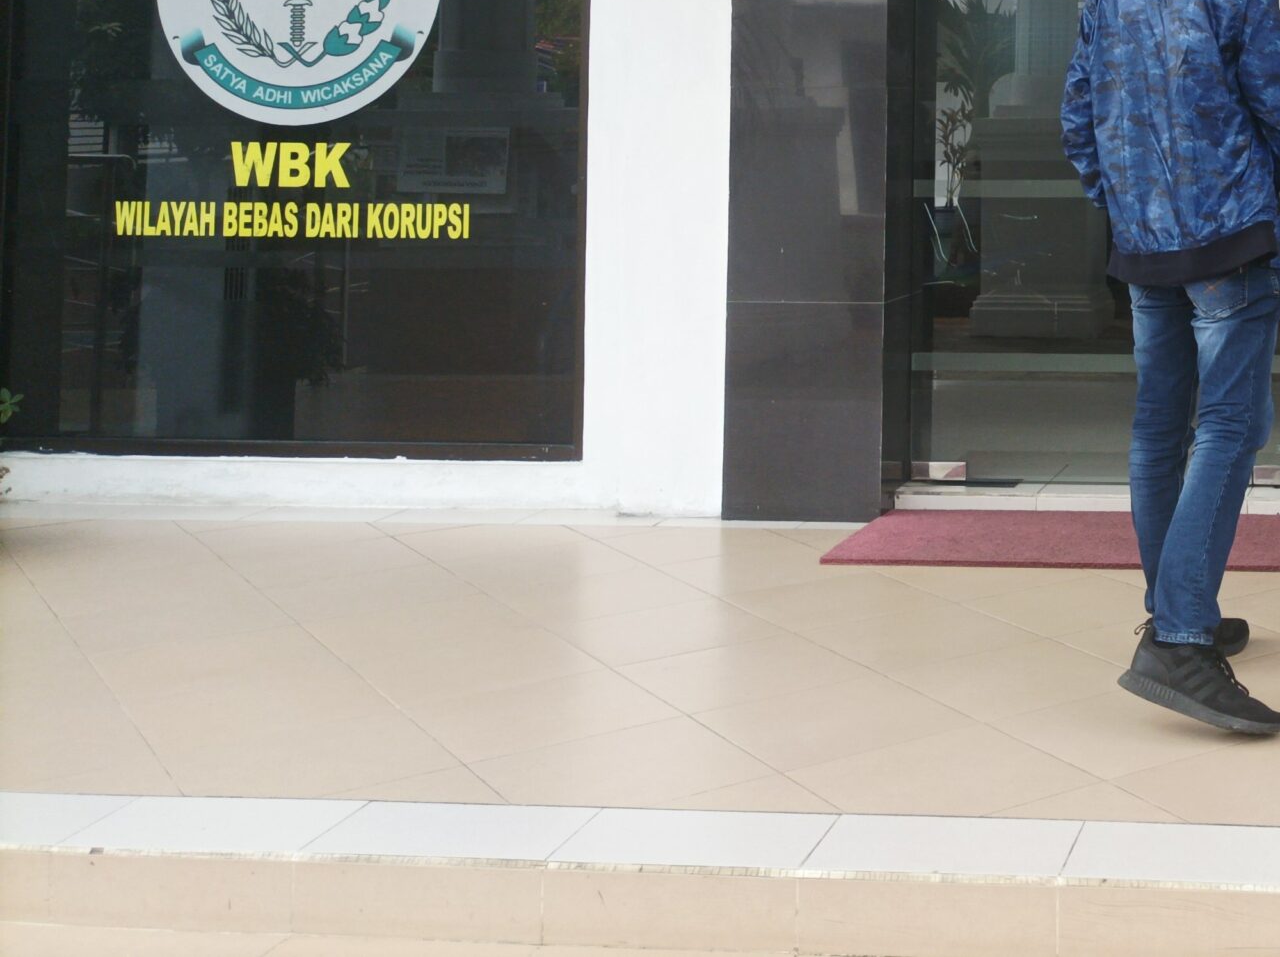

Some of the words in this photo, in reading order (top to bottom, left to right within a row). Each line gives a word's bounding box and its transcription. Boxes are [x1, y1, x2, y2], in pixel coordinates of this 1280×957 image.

[203, 53, 248, 94] SATYA
[252, 89, 293, 105] ADHI
[300, 50, 393, 105] WICAKSANA
[231, 141, 352, 189] WBK
[115, 201, 217, 238] WILAYAH
[222, 200, 300, 239] BEBAS
[305, 201, 361, 240] DARI
[366, 201, 470, 240] KORUPSI
